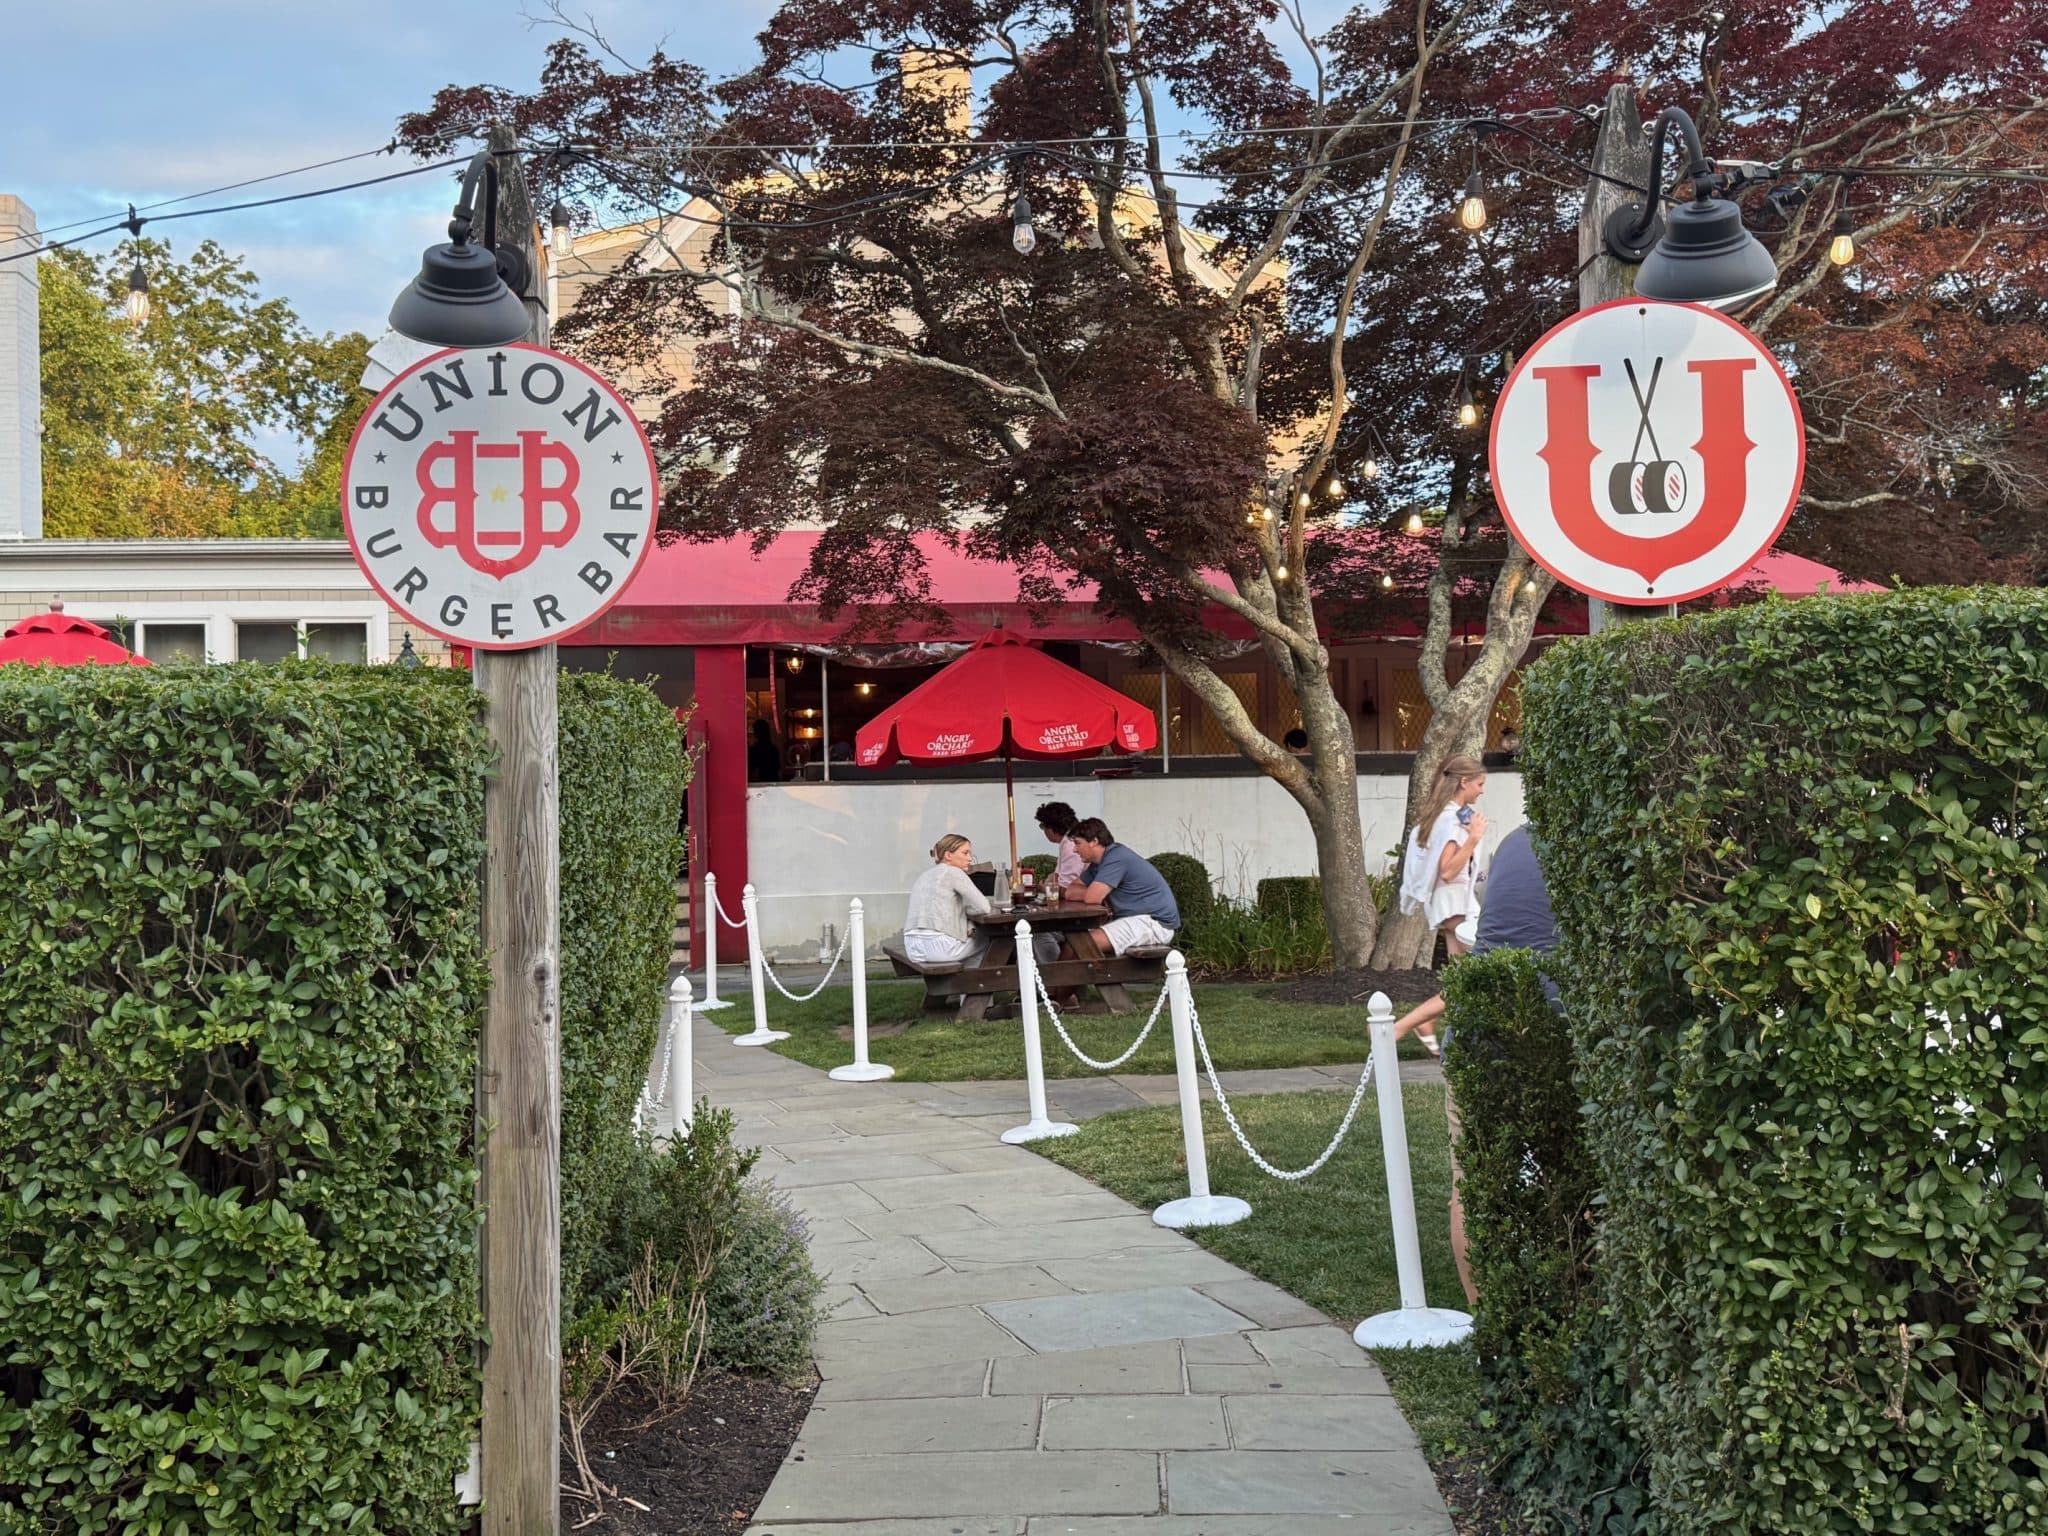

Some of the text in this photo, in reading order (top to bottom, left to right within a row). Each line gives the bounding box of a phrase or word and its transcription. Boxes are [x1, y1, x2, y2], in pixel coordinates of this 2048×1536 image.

[372, 355, 622, 443] UNION
[1532, 358, 1758, 585] U
[355, 486, 643, 635] BURGER BAR
[936, 734, 971, 743] ANGRY
[1039, 731, 1089, 745] ORCHARD
[1044, 723, 1078, 737] ANGRY
